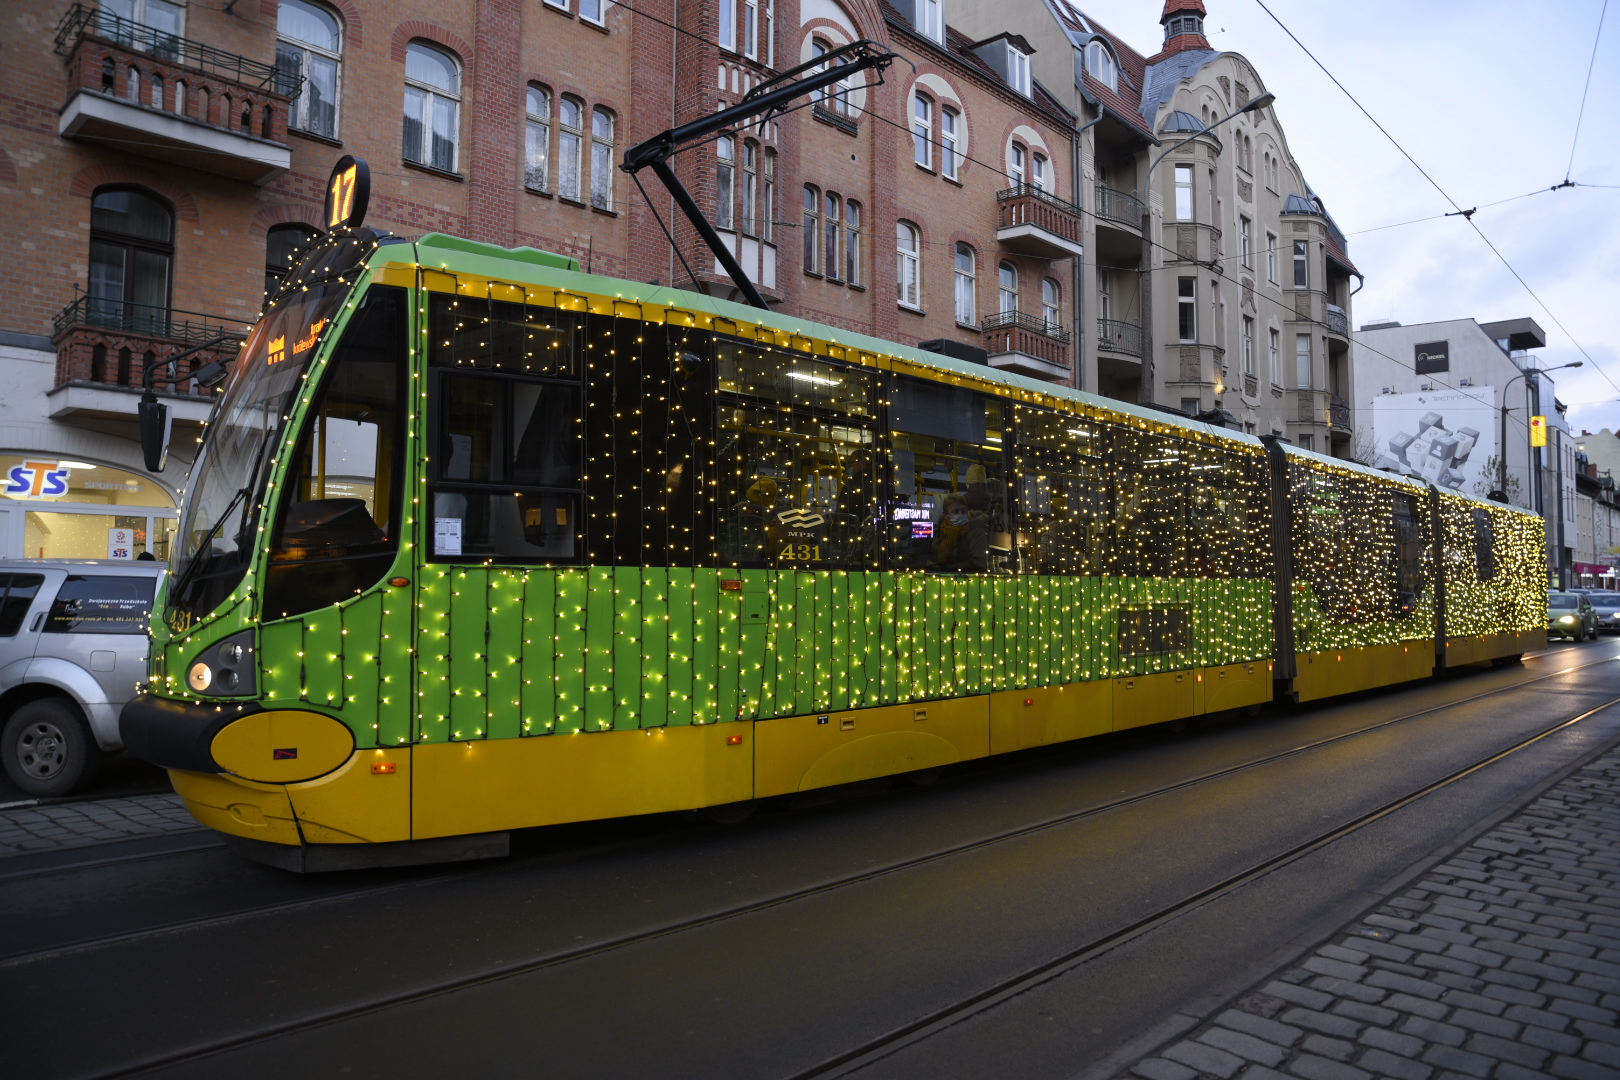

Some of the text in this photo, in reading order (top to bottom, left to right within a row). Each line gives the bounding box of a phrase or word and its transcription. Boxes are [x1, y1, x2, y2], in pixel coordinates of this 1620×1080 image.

[329, 163, 357, 228] 17
[6, 461, 69, 497] STS
[112, 548, 128, 558] STS
[780, 543, 822, 561] 431
[170, 610, 192, 631] 431
